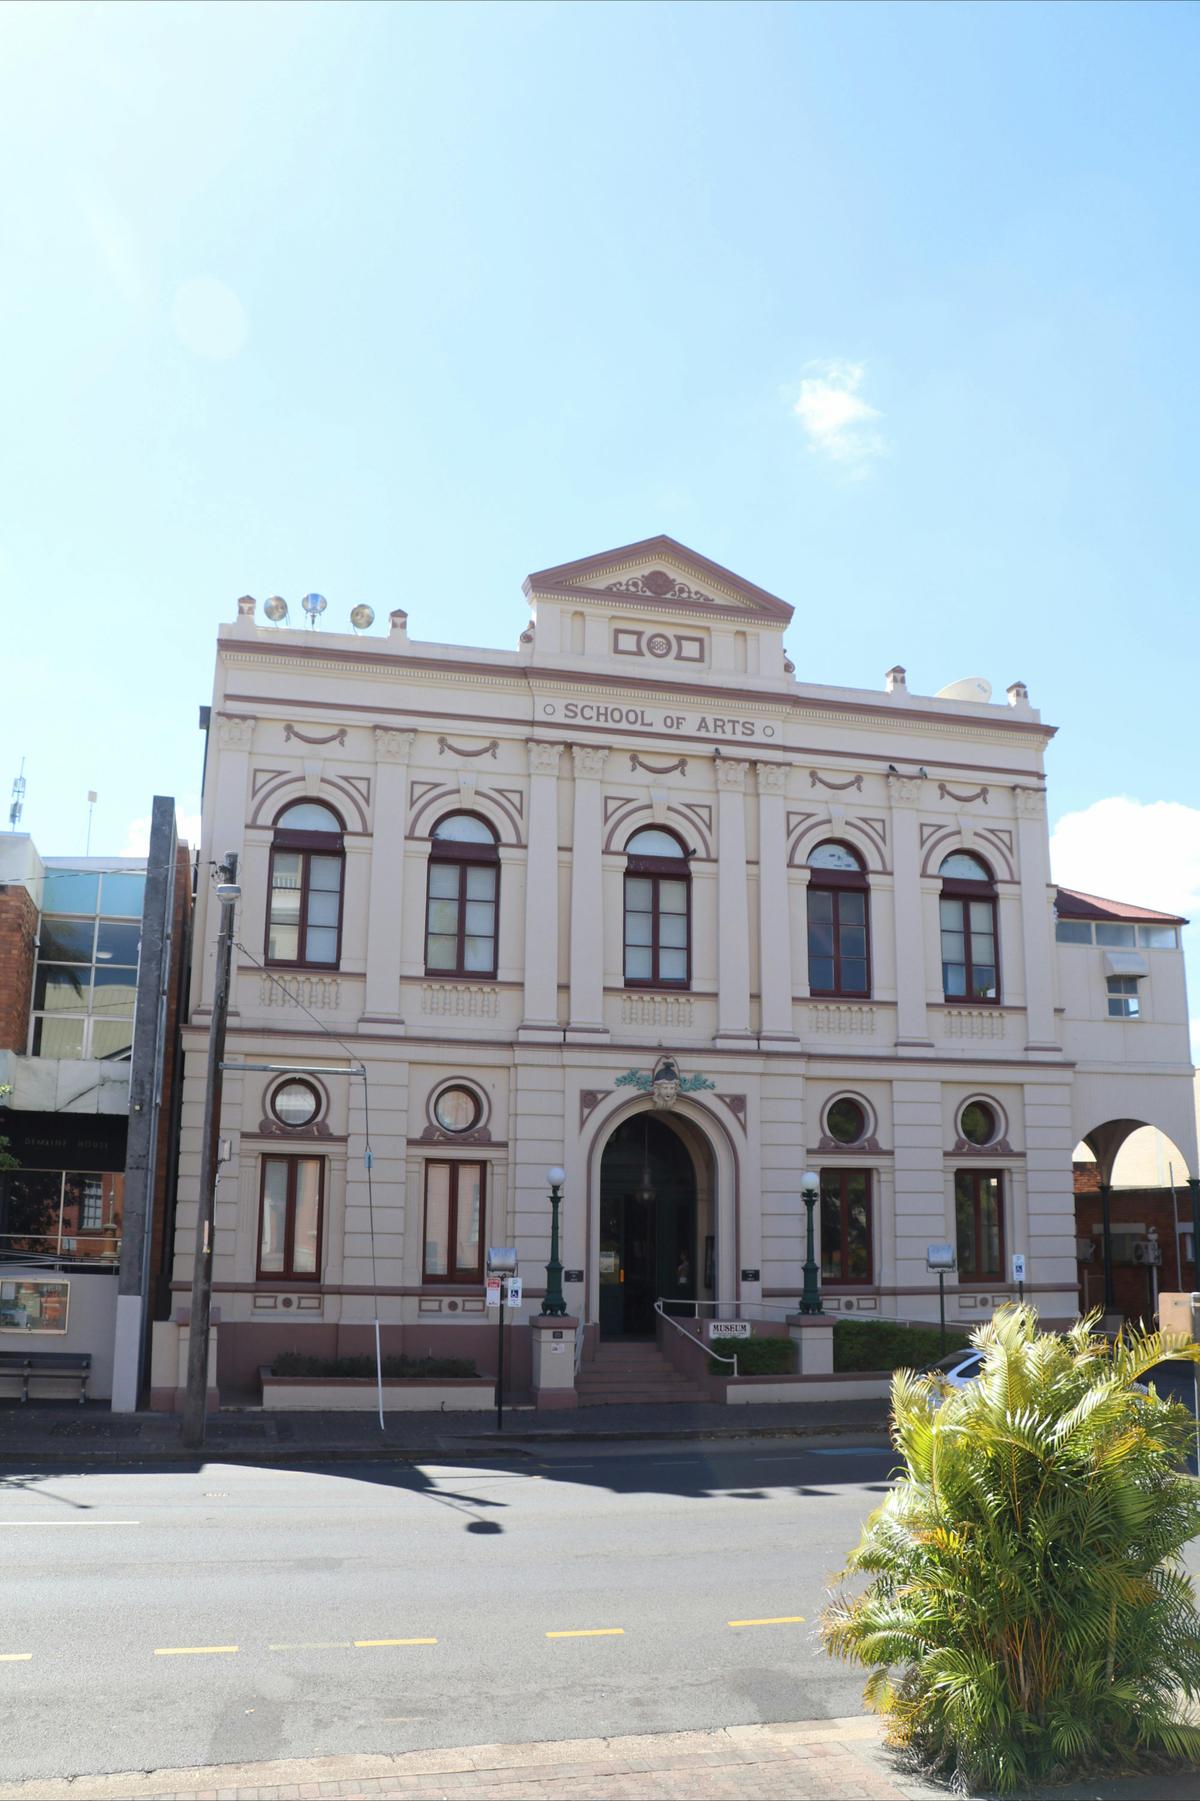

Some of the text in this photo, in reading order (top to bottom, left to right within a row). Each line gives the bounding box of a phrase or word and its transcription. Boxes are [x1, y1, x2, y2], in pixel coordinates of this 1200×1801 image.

[564, 703, 755, 736] SCHOOL OF ARTS
[713, 1324, 747, 1332] MUSEUM
